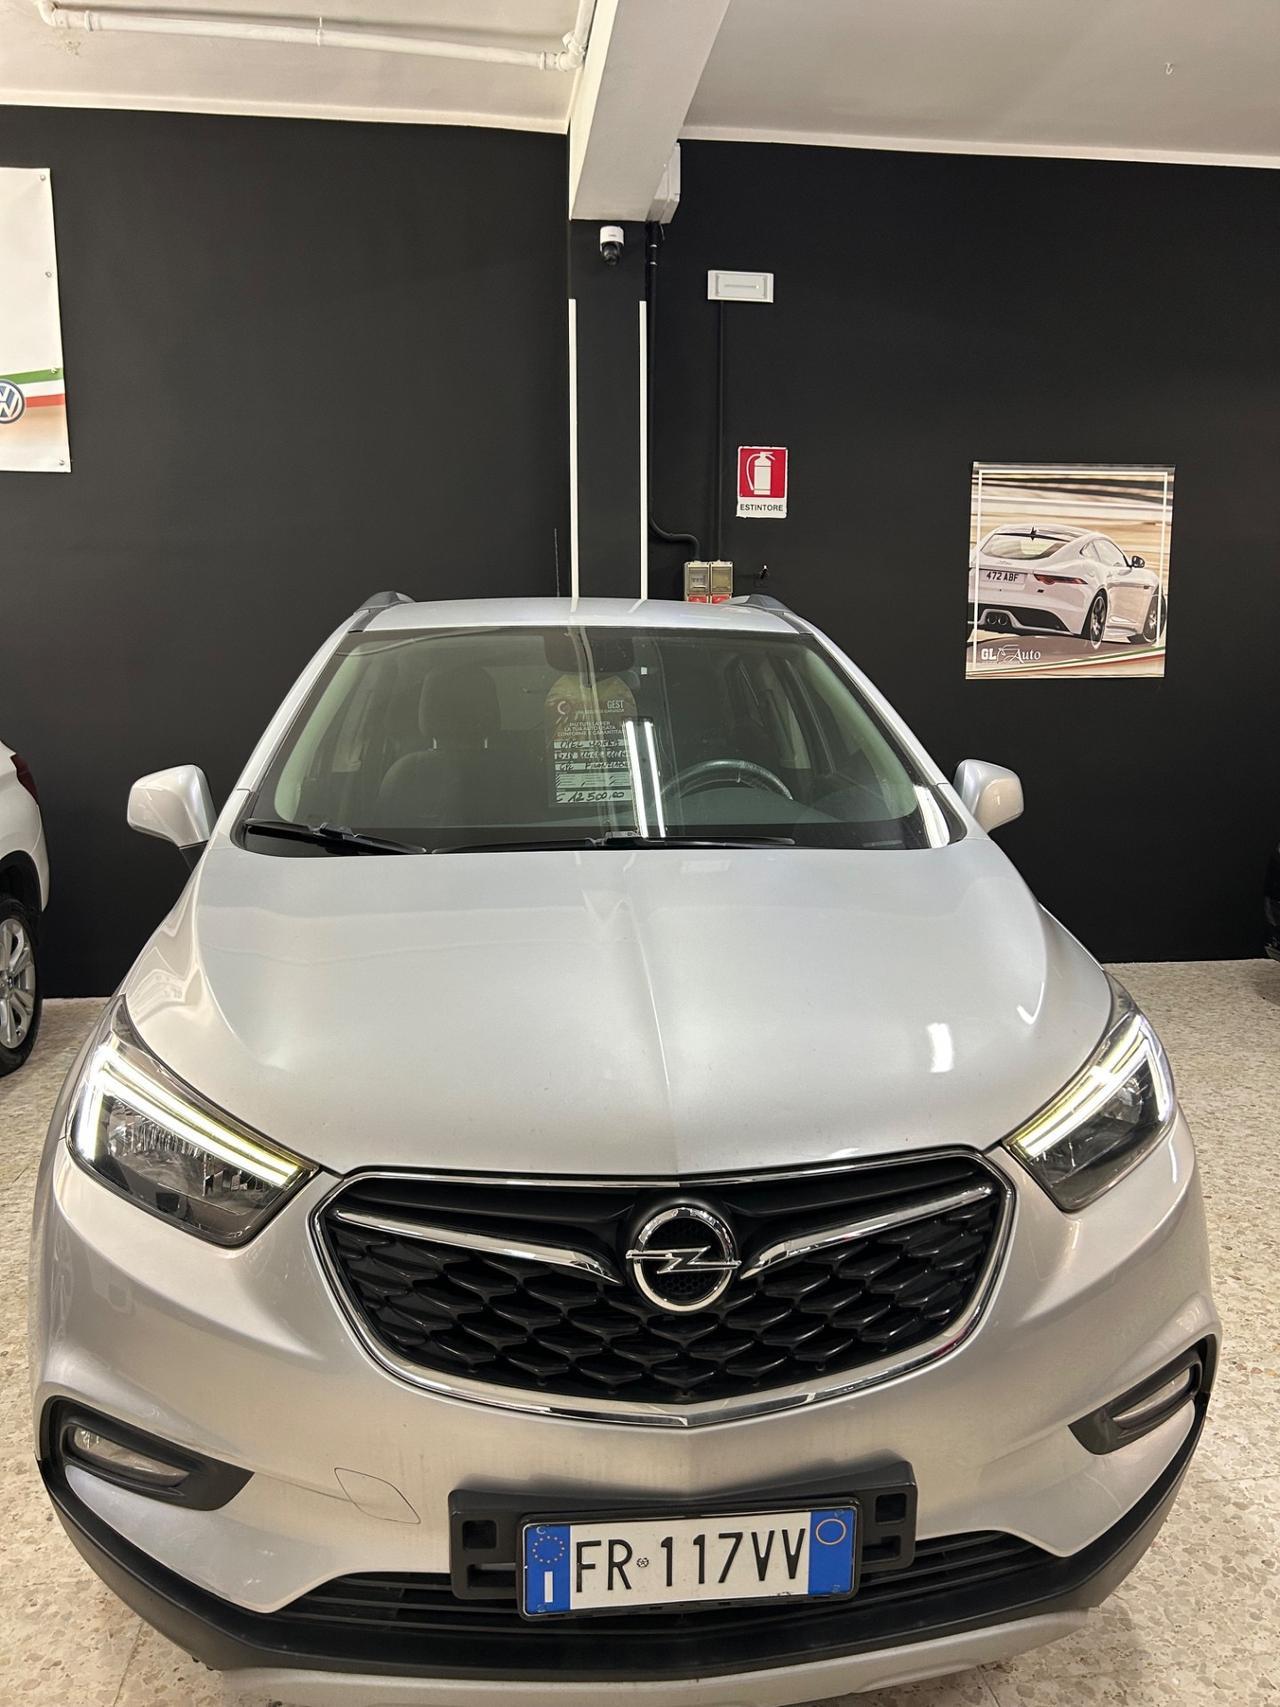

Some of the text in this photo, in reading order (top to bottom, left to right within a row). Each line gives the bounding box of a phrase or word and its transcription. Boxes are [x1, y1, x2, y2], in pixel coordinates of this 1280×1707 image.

[986, 571, 1019, 582] 472 ABF
[981, 648, 997, 661] GL
[607, 700, 624, 709] GEST
[576, 1528, 806, 1593] FR 117VV
